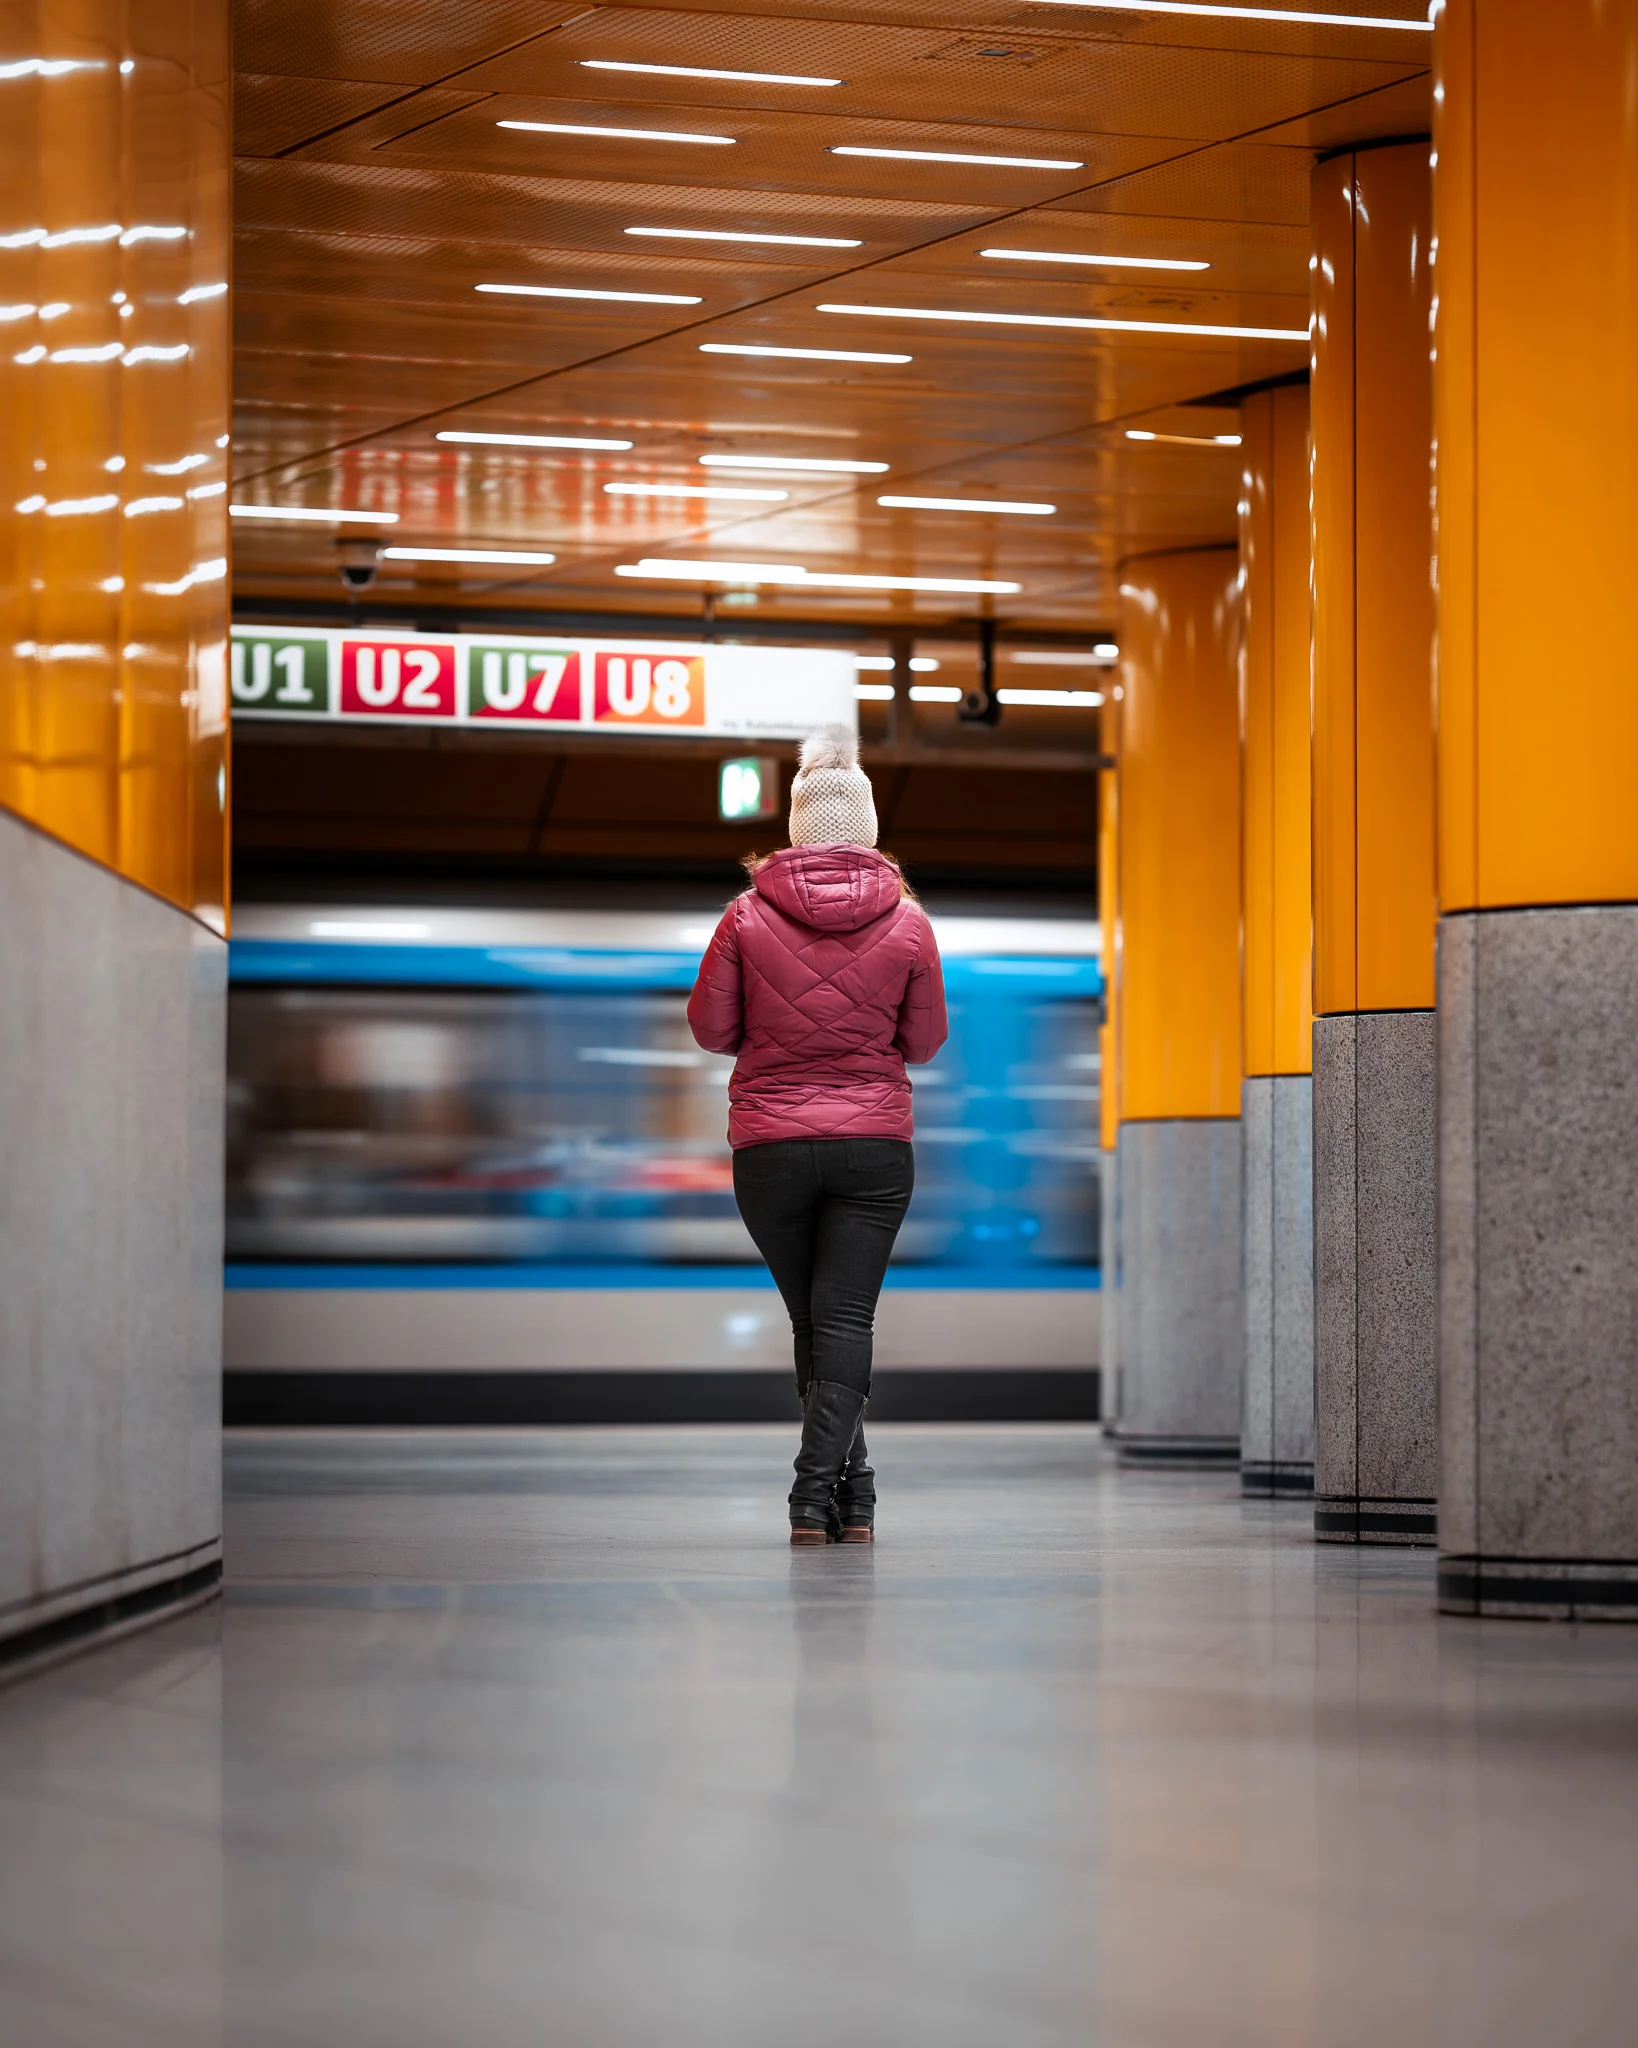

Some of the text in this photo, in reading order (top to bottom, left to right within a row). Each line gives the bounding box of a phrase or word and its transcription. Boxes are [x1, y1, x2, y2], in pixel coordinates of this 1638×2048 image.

[231, 642, 691, 718] U1 U2 U7 U8
